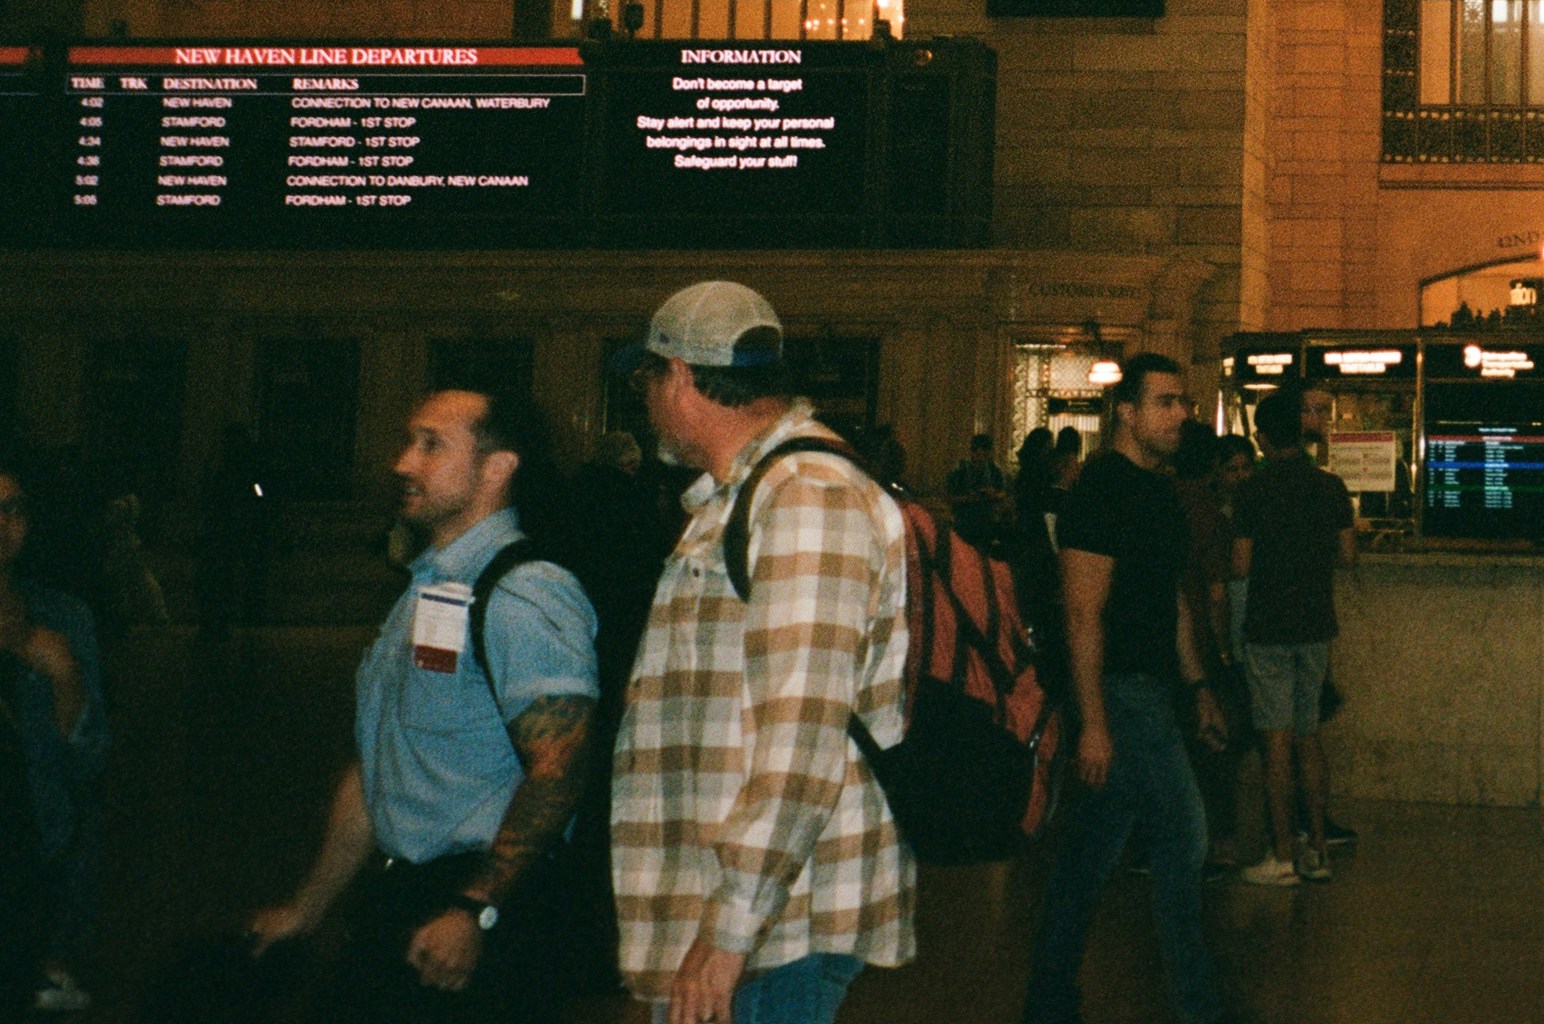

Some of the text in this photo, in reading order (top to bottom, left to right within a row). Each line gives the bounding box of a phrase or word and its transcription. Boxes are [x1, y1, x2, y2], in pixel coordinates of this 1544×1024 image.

[176, 49, 477, 65] NEW HAVEN LINE DEPARTURES
[682, 50, 801, 63] INFORMATION
[71, 77, 359, 90] TIME TRK DESTINATION REMARKS
[673, 77, 802, 92] Don't become a target
[163, 97, 190, 108] NEW
[192, 97, 232, 108] HAVEN
[292, 97, 371, 108] CONNECTION
[374, 98, 390, 108] TO
[392, 98, 420, 108] NEW
[476, 98, 550, 108] WATERBURY
[697, 97, 779, 111] of opportunity.
[162, 117, 226, 127] STAMFORD
[291, 117, 351, 128] FORDHAM
[361, 117, 382, 128] 1ST
[384, 117, 416, 128] STOP
[637, 116, 834, 131] Stay alert and keep your personal
[161, 136, 188, 147] NEW
[190, 136, 229, 147] HAVEN
[290, 136, 355, 147] STAMFORD
[365, 136, 386, 147] 1ST
[388, 137, 420, 147] STOP
[647, 136, 825, 150] belongings in sight at all times.
[160, 156, 223, 166] STAMFORD
[288, 156, 348, 167] FORDHAM
[359, 156, 379, 167] 1ST
[382, 156, 414, 167] STOP
[674, 155, 797, 170] Safeguard your stuff!
[158, 176, 185, 186] NEW
[187, 175, 227, 186] HAVEN
[287, 176, 366, 186] CONNECTION
[369, 176, 385, 186] TO
[448, 176, 476, 186] NEW
[478, 176, 528, 186] CANAAN
[157, 195, 220, 205] STAMFORD
[286, 195, 346, 206] FORDHAM
[356, 195, 377, 206] 1ST
[379, 195, 411, 206] STOP
